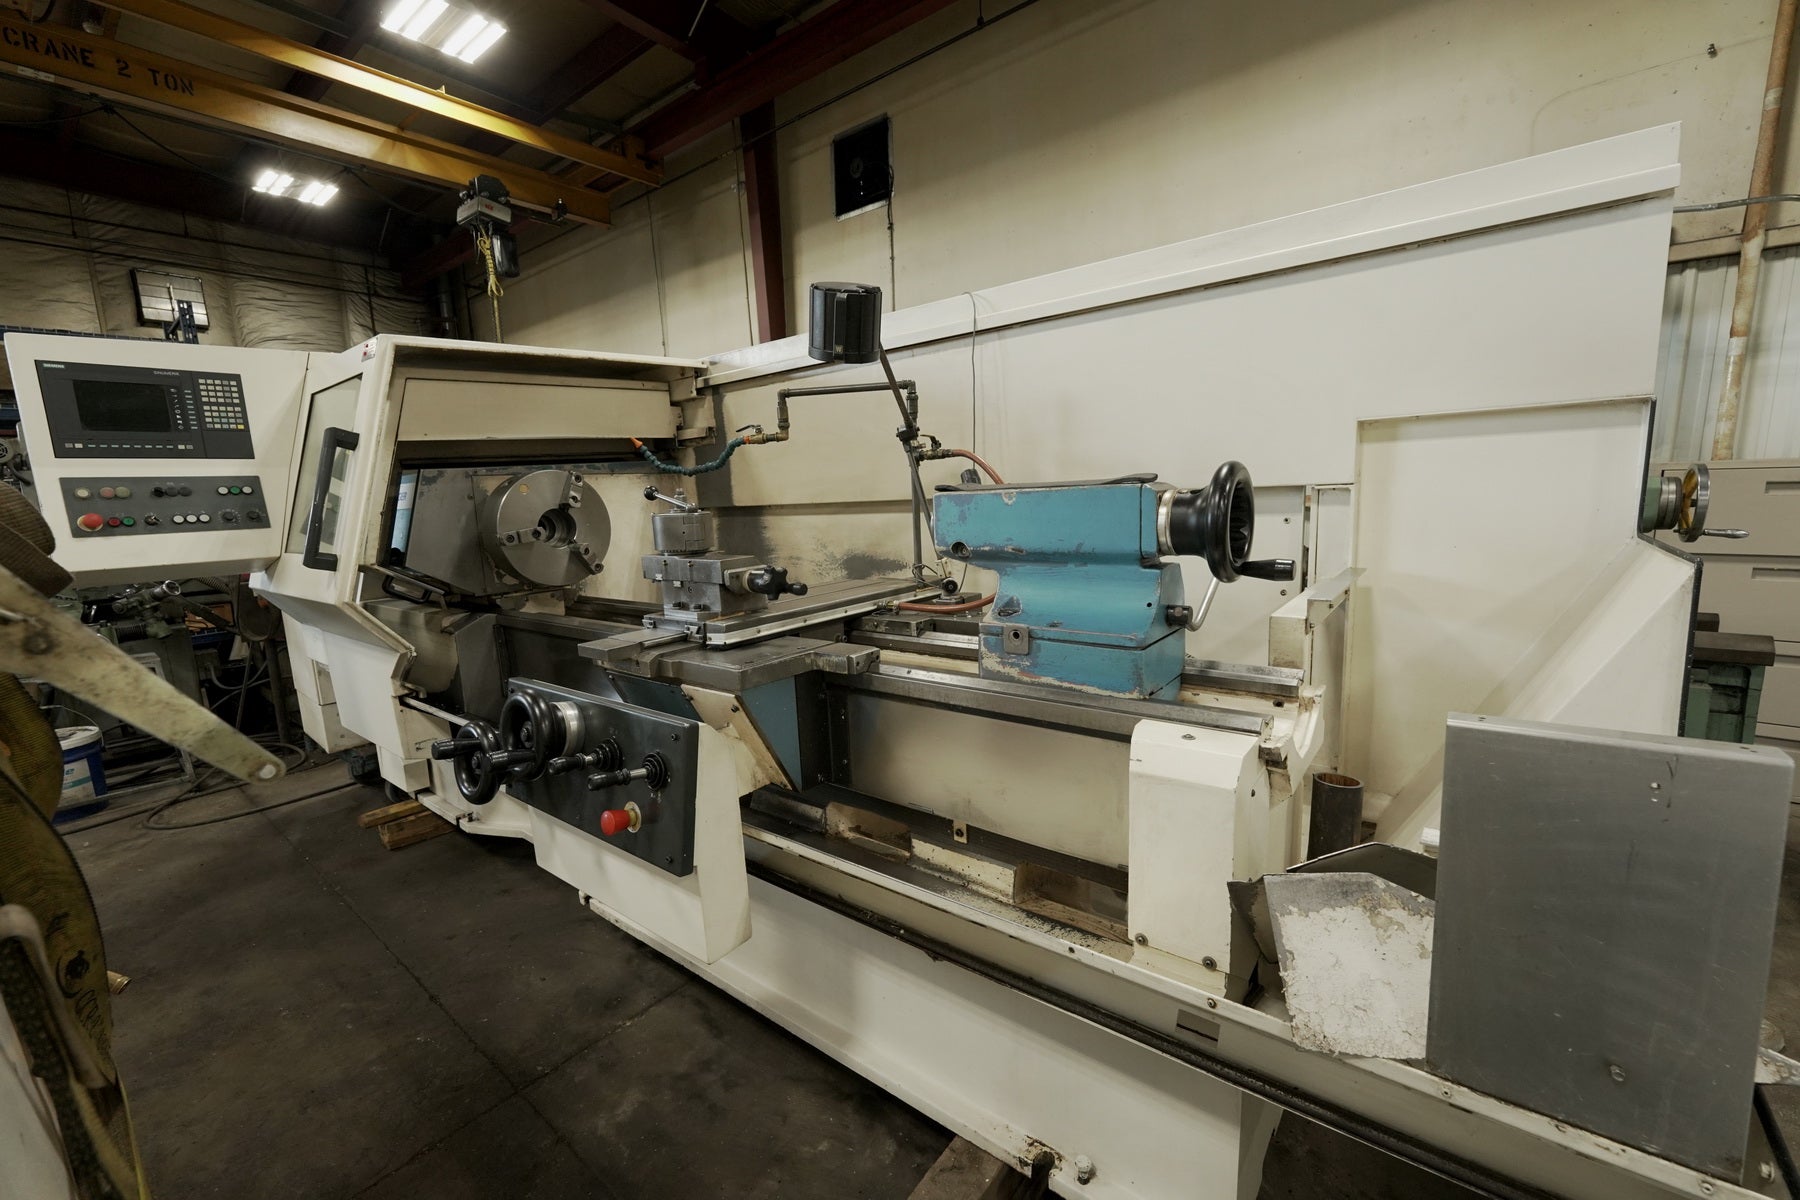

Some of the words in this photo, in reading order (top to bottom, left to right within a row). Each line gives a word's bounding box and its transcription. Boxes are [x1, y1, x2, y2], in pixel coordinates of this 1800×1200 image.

[2, 26, 95, 68] CRANE
[115, 58, 132, 78] 2
[148, 67, 195, 97] TON
